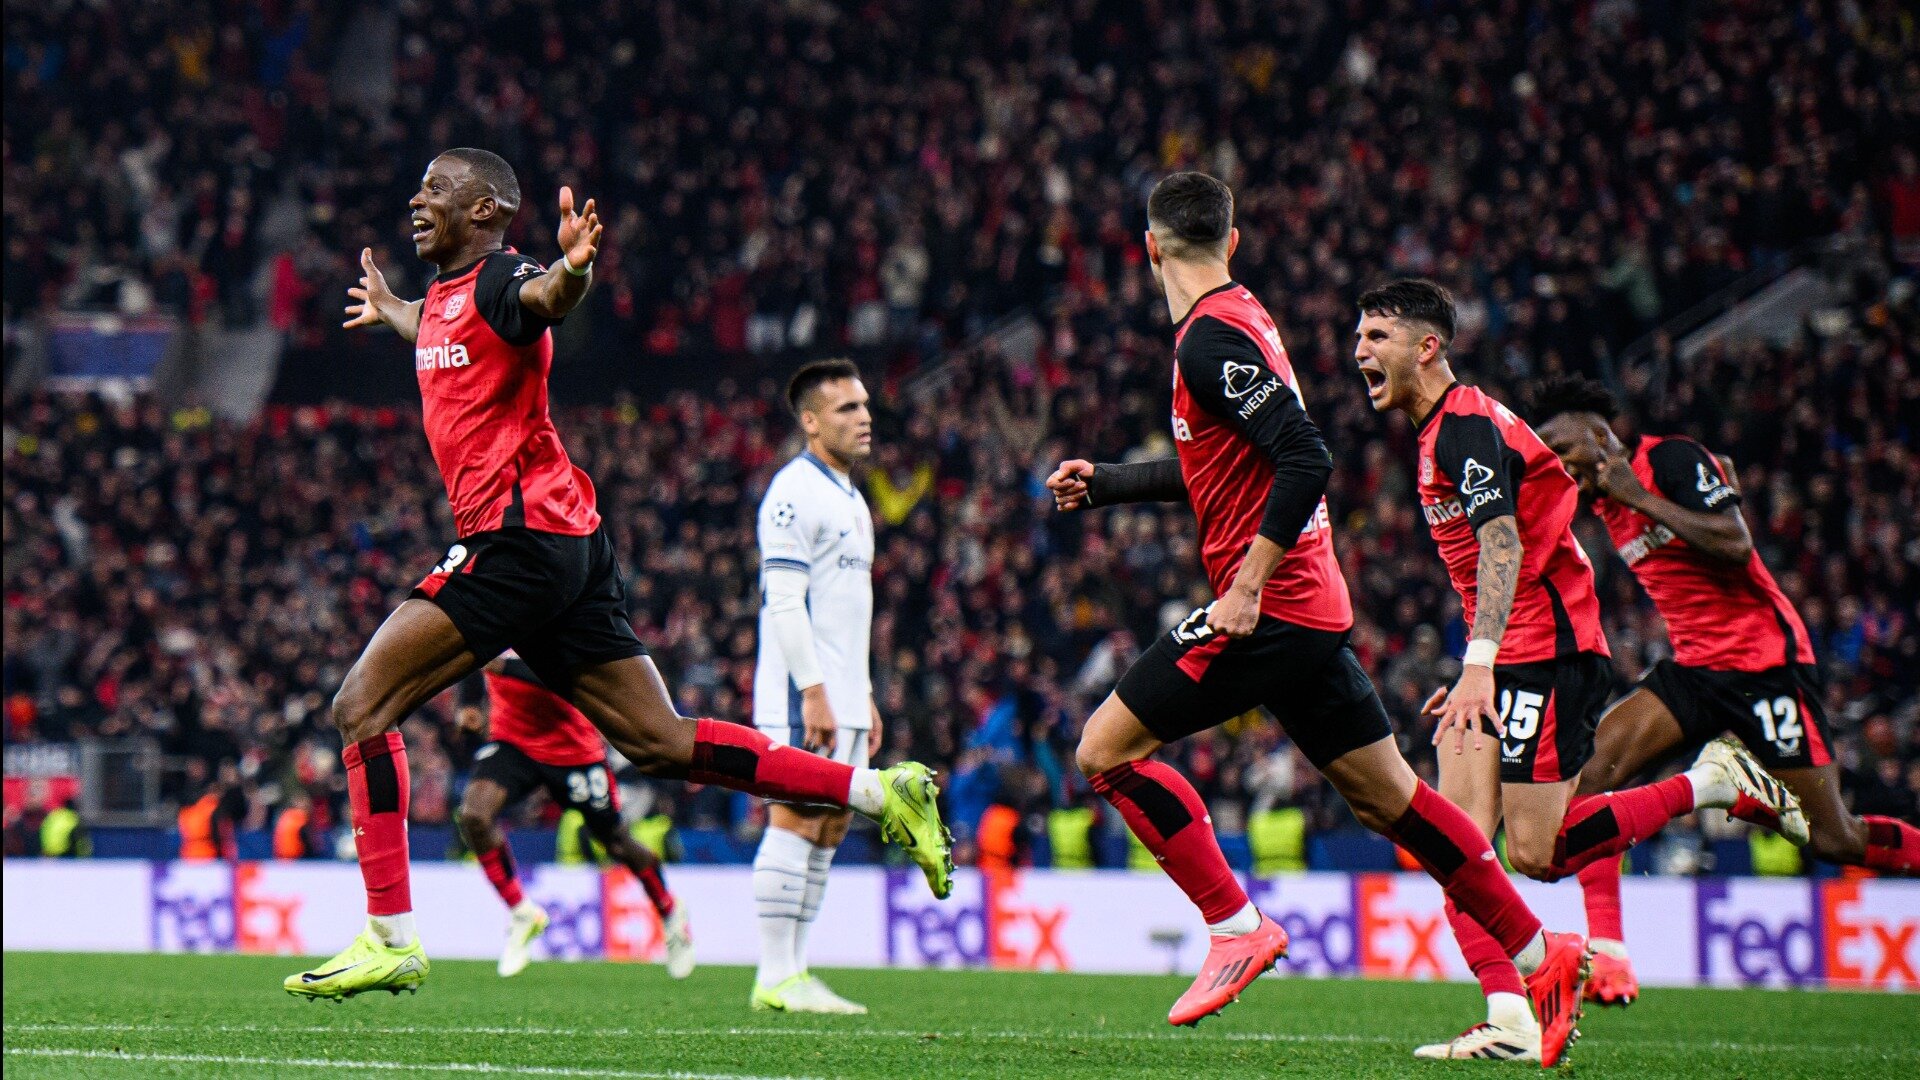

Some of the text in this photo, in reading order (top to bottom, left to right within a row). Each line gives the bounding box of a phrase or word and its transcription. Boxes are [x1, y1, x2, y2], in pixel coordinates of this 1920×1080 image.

[1238, 377, 1283, 420] NIEDAX
[1465, 487, 1503, 518] NDAX
[1499, 688, 1544, 740] 25
[1753, 695, 1804, 741] 12
[566, 765, 609, 803] 30
[884, 867, 1072, 971] FedEx
[1697, 877, 1919, 991] FedEx
